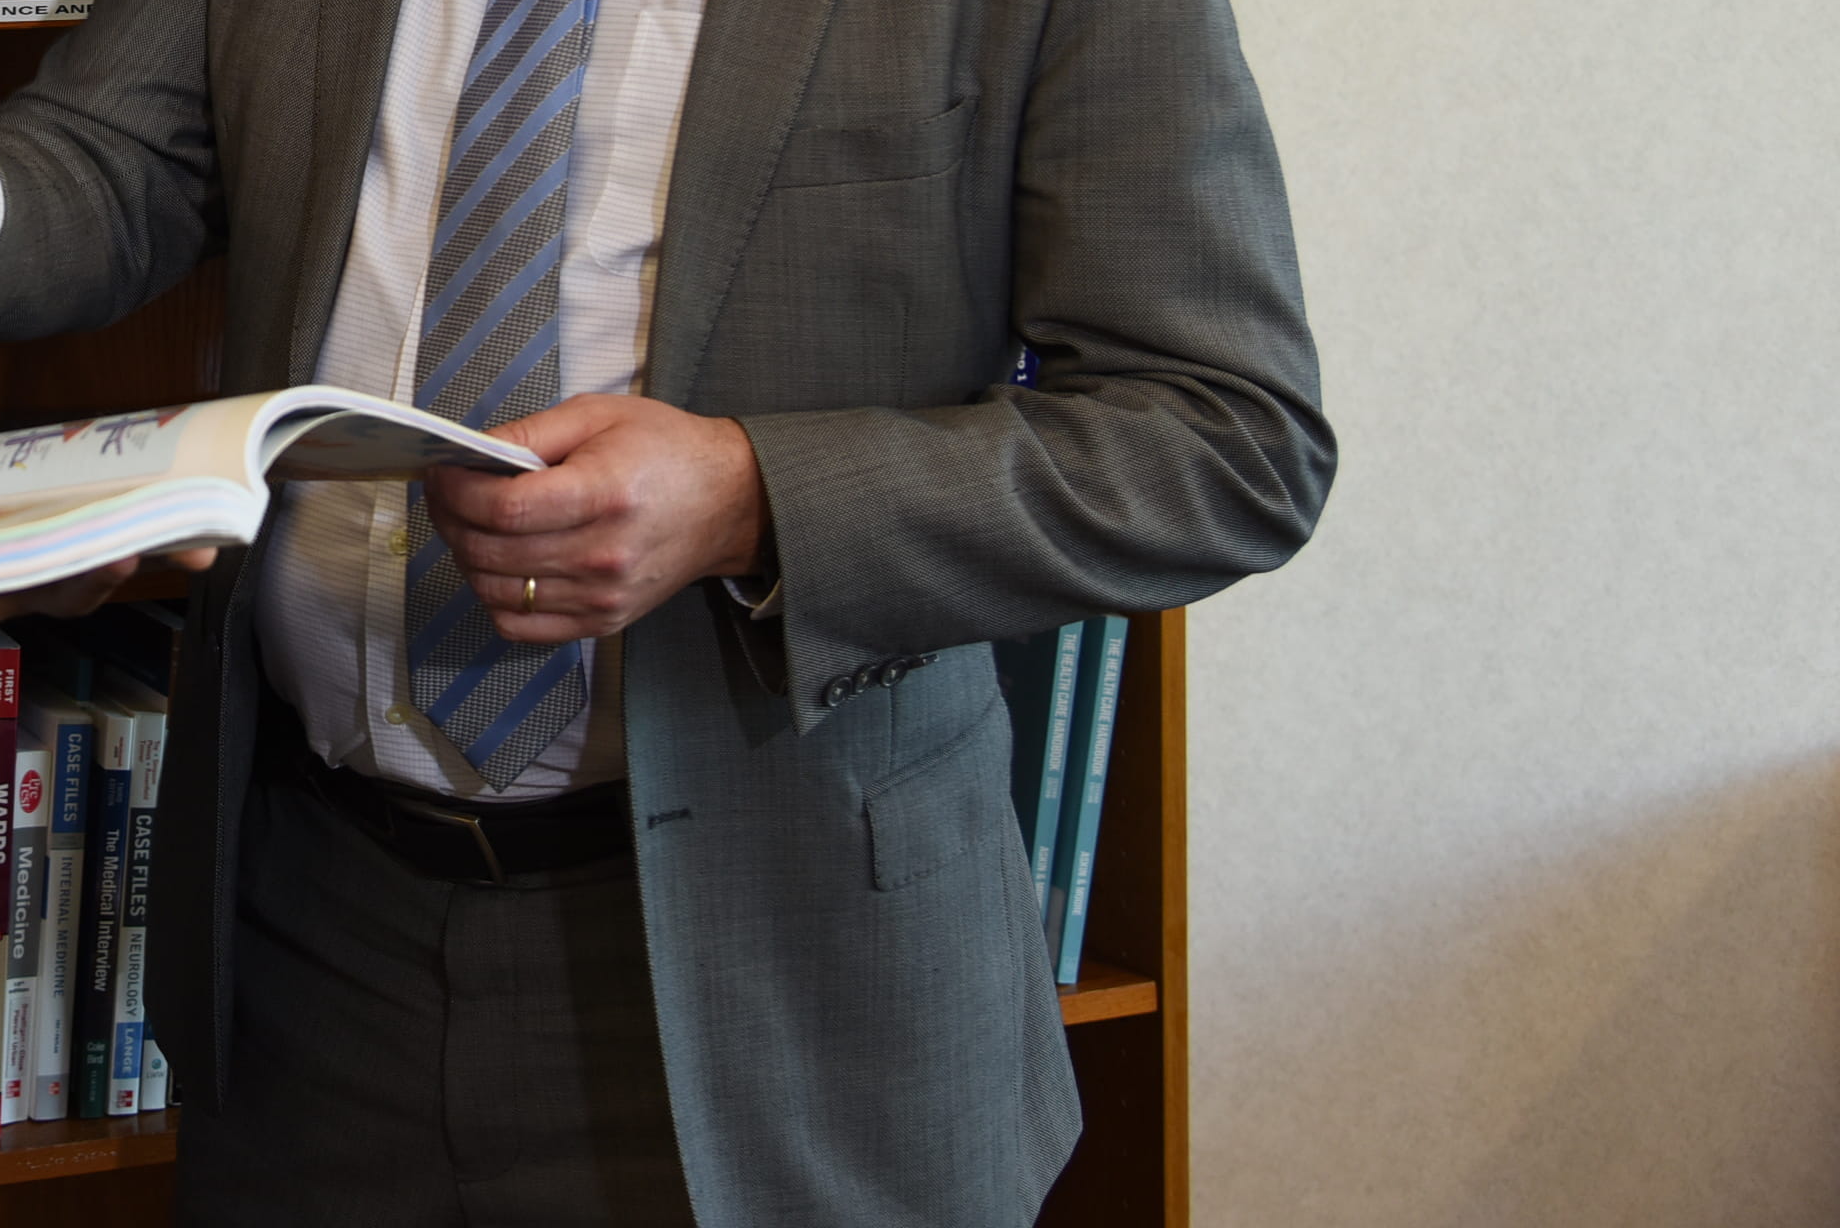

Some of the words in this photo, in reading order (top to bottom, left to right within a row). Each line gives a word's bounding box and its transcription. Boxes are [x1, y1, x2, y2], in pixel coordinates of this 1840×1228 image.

[1061, 633, 1078, 652] THE
[1107, 638, 1122, 656] THE
[4, 668, 15, 703] FIRST
[1057, 652, 1075, 691] HEALTH
[1102, 657, 1119, 696] HEALTH
[1054, 691, 1070, 718] CARE
[1097, 696, 1114, 722] CARE
[66, 732, 83, 773] CASE
[1048, 718, 1066, 772] HANDBOOK
[1092, 722, 1110, 776] HANDBOOK
[63, 777, 80, 822] FILES
[105, 829, 120, 853] The
[133, 814, 152, 861] CASE
[13, 845, 34, 960] Medicine
[56, 856, 73, 927] INTERNAL
[99, 856, 119, 917] Medical
[130, 864, 149, 918] FILES
[54, 929, 70, 997] MEDICINE
[94, 921, 114, 992] Interview
[126, 932, 143, 1018] NEUROLOGY
[121, 1026, 135, 1075] LANGE
